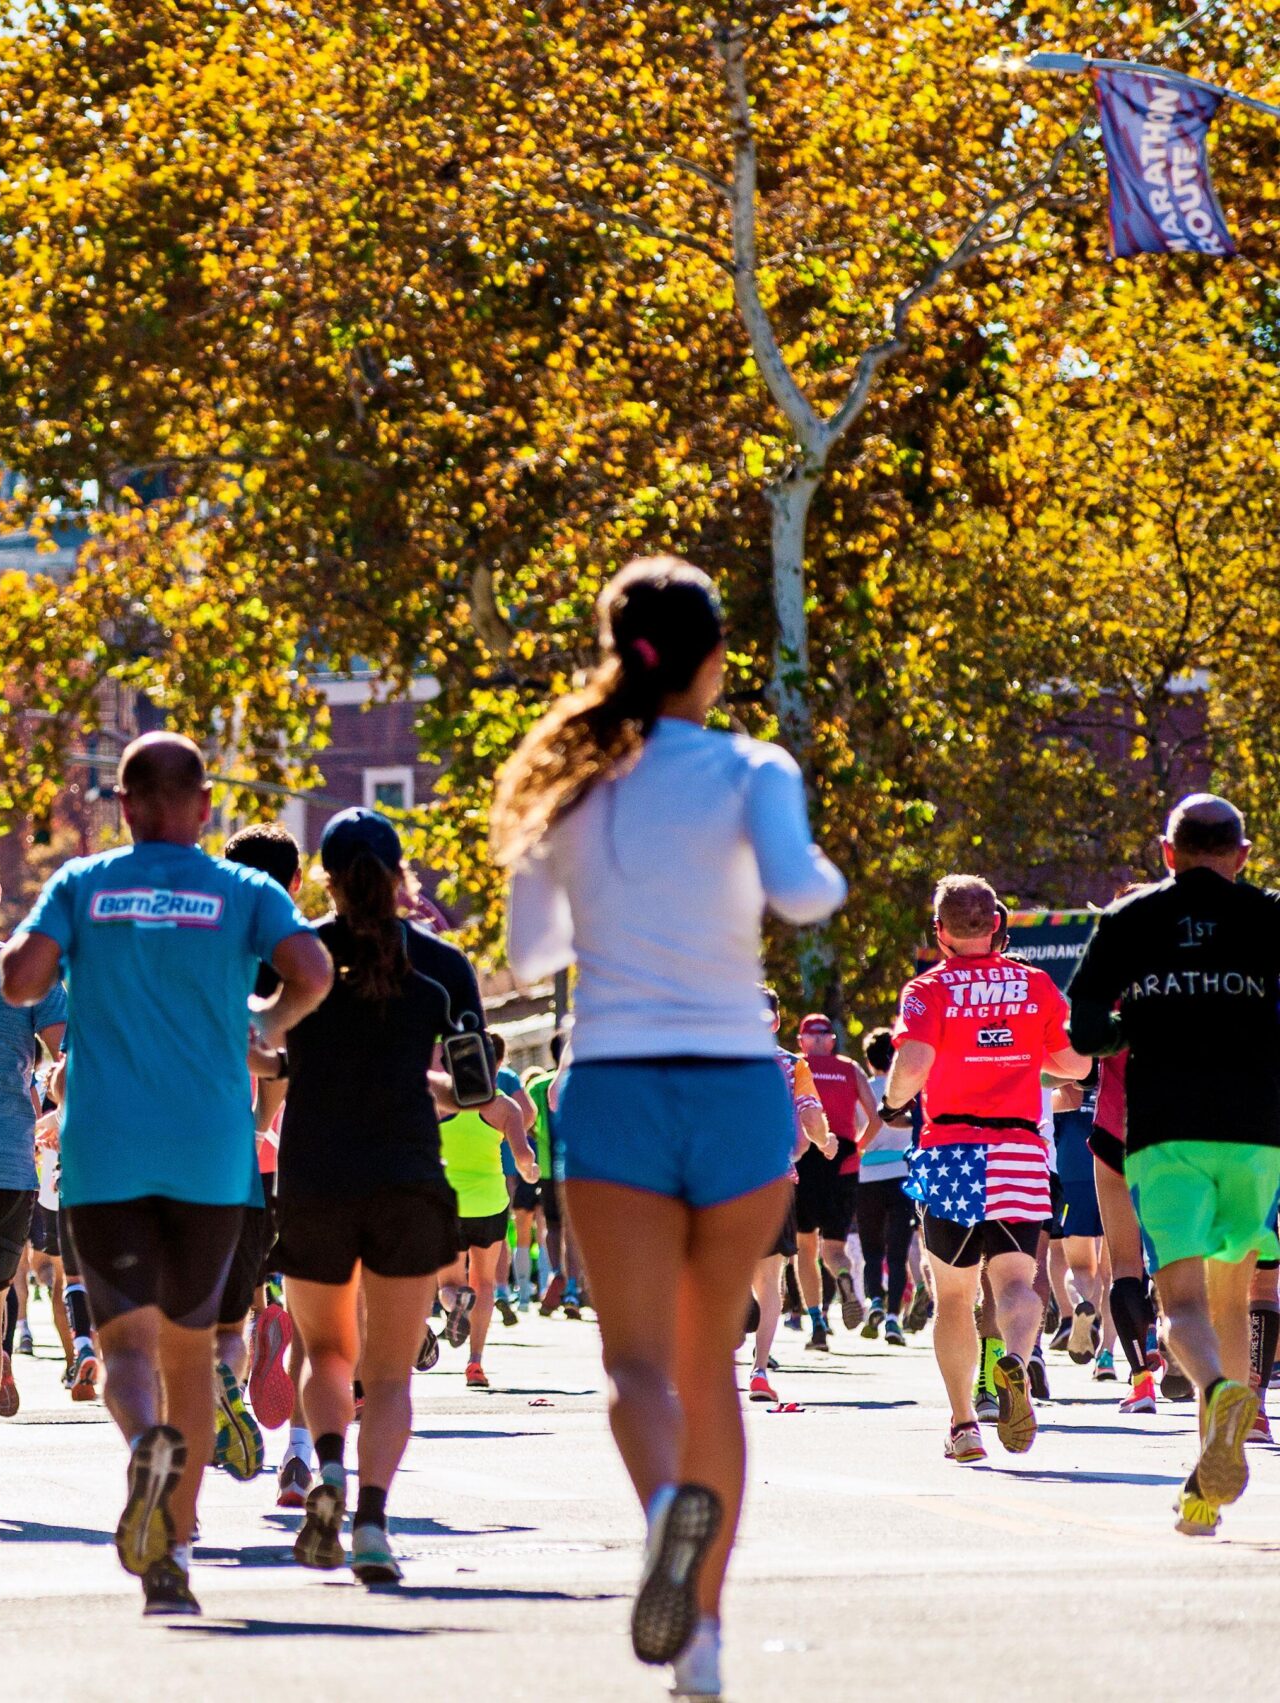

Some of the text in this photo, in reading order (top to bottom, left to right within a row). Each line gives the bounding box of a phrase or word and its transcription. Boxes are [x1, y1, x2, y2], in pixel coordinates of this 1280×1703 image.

[1171, 146, 1227, 255] ROUTE
[99, 894, 214, 915] Born2Run
[1177, 916, 1218, 947] 1ST
[940, 966, 1029, 984] DWIGHT
[949, 980, 1029, 1006] TMB
[945, 1003, 1038, 1018] RACING
